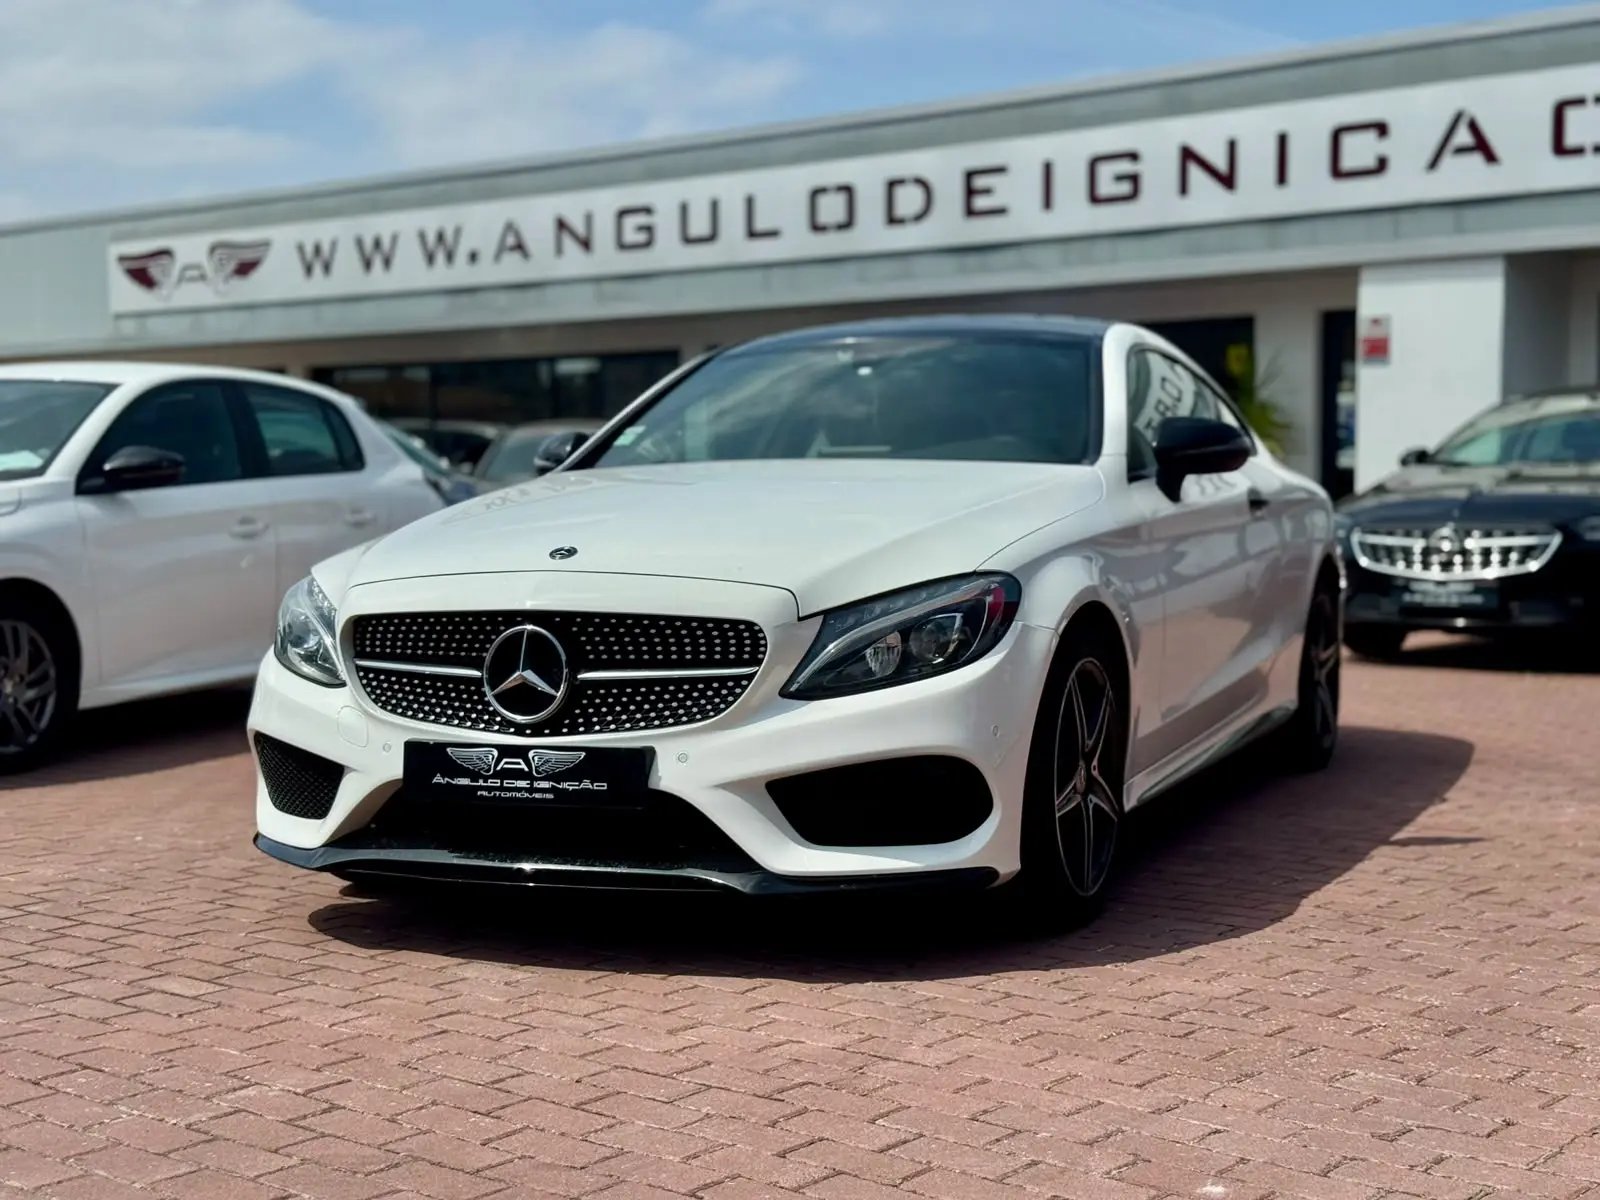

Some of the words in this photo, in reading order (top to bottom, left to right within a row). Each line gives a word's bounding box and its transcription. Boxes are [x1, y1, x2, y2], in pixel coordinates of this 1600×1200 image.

[432, 773, 500, 787] ÂNGULO
[503, 779, 531, 788] DE
[533, 779, 608, 791] IGNIÇÃO
[477, 790, 554, 799] AUTOMÓVEIS
